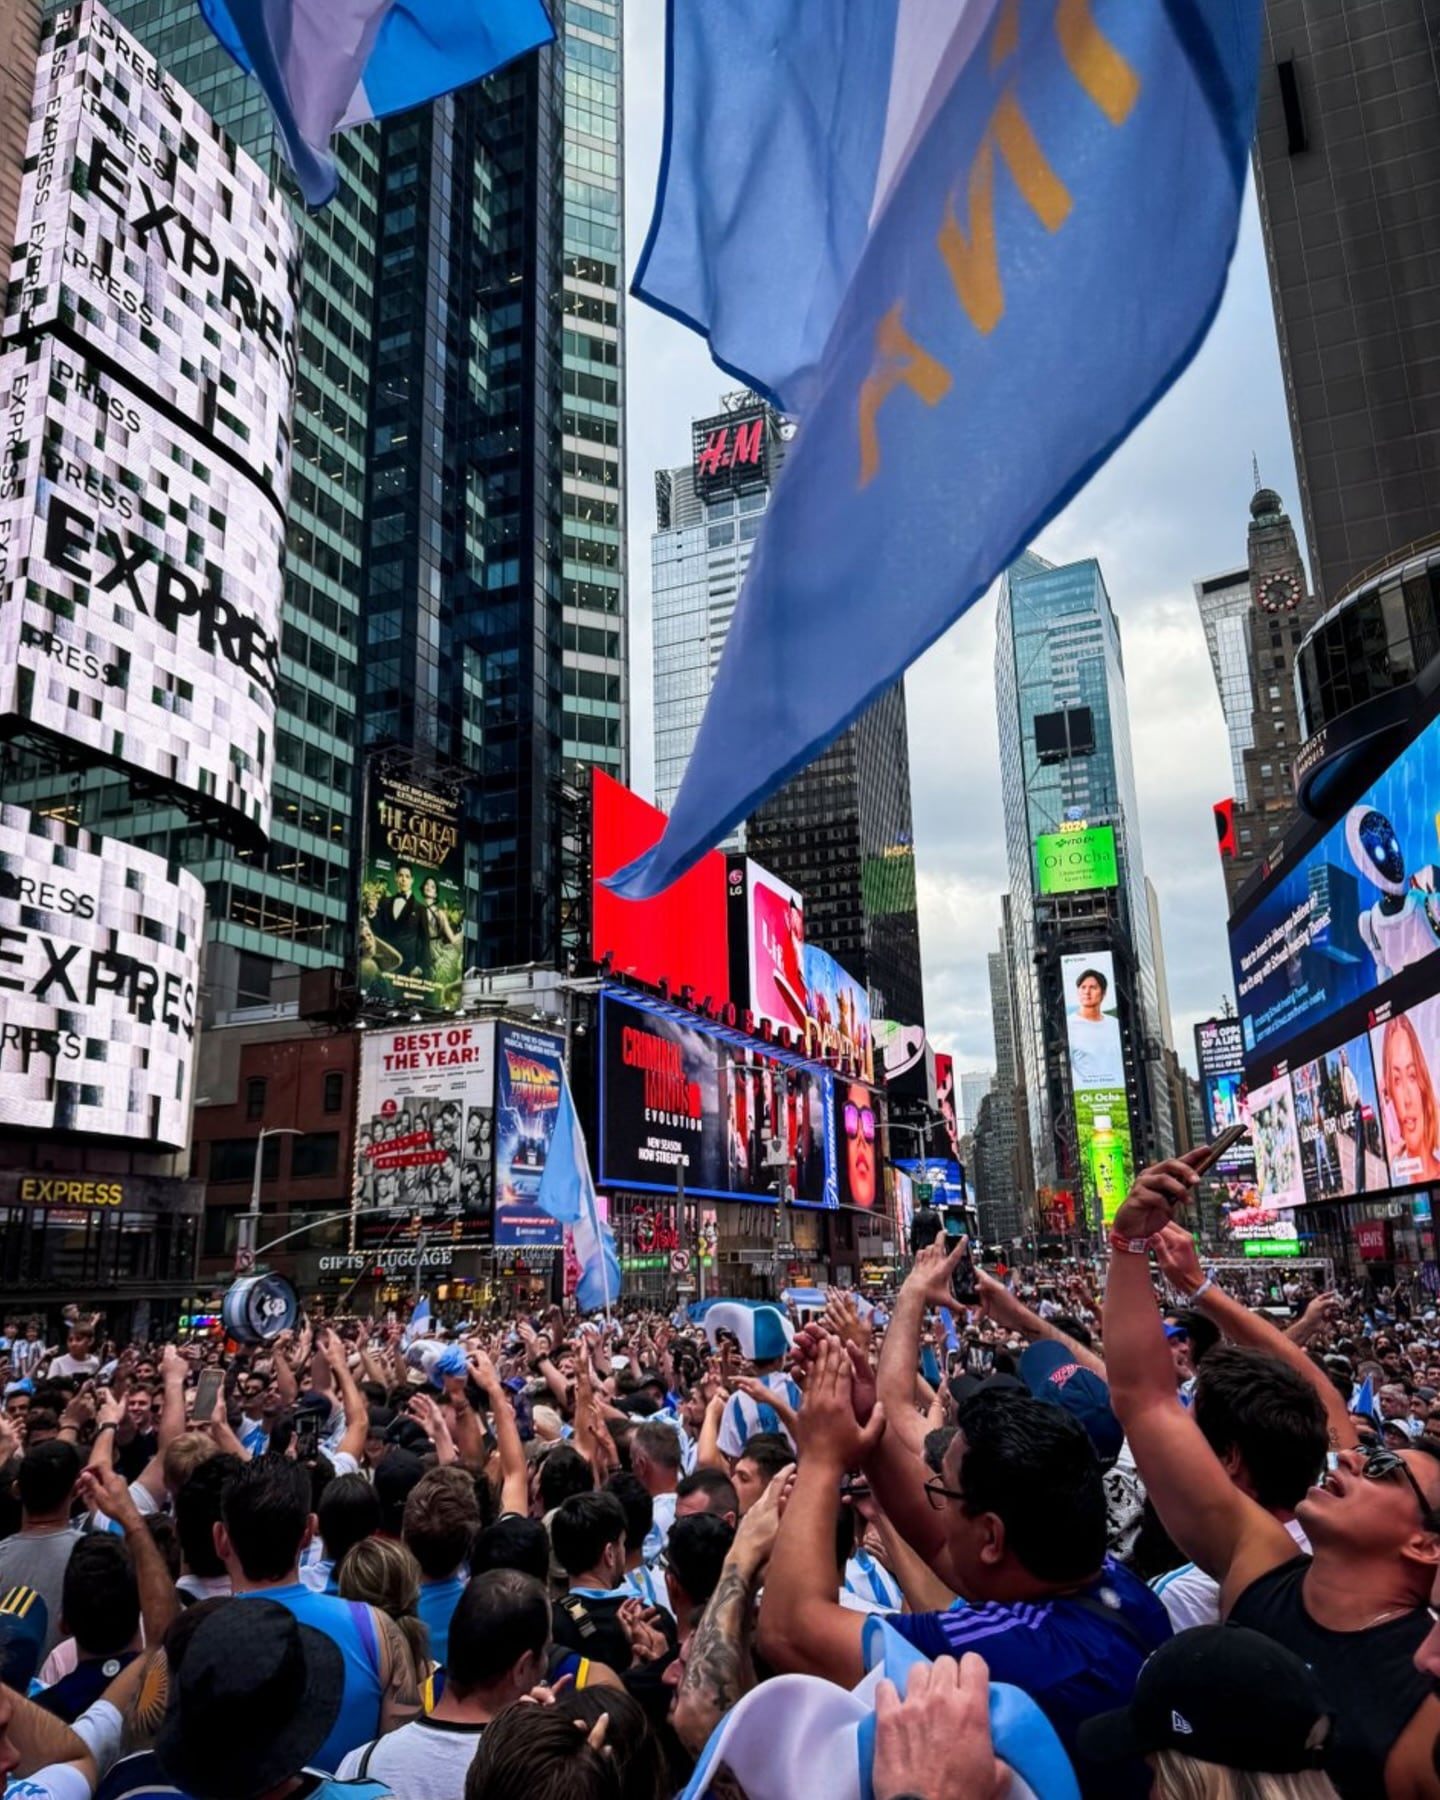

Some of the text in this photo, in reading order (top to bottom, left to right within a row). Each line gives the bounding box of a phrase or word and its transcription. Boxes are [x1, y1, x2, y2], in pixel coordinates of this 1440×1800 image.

[697, 418, 764, 477] H&M
[729, 885, 743, 896] LG
[393, 1028, 473, 1052] BEST OF
[622, 1025, 683, 1076] CRIMINAL
[383, 1046, 480, 1071] THE YEAR!
[644, 1107, 702, 1131] EVOLUTION
[21, 1179, 122, 1206] EXPRESS
[319, 1250, 453, 1270] GIFTS LUGGAGE
